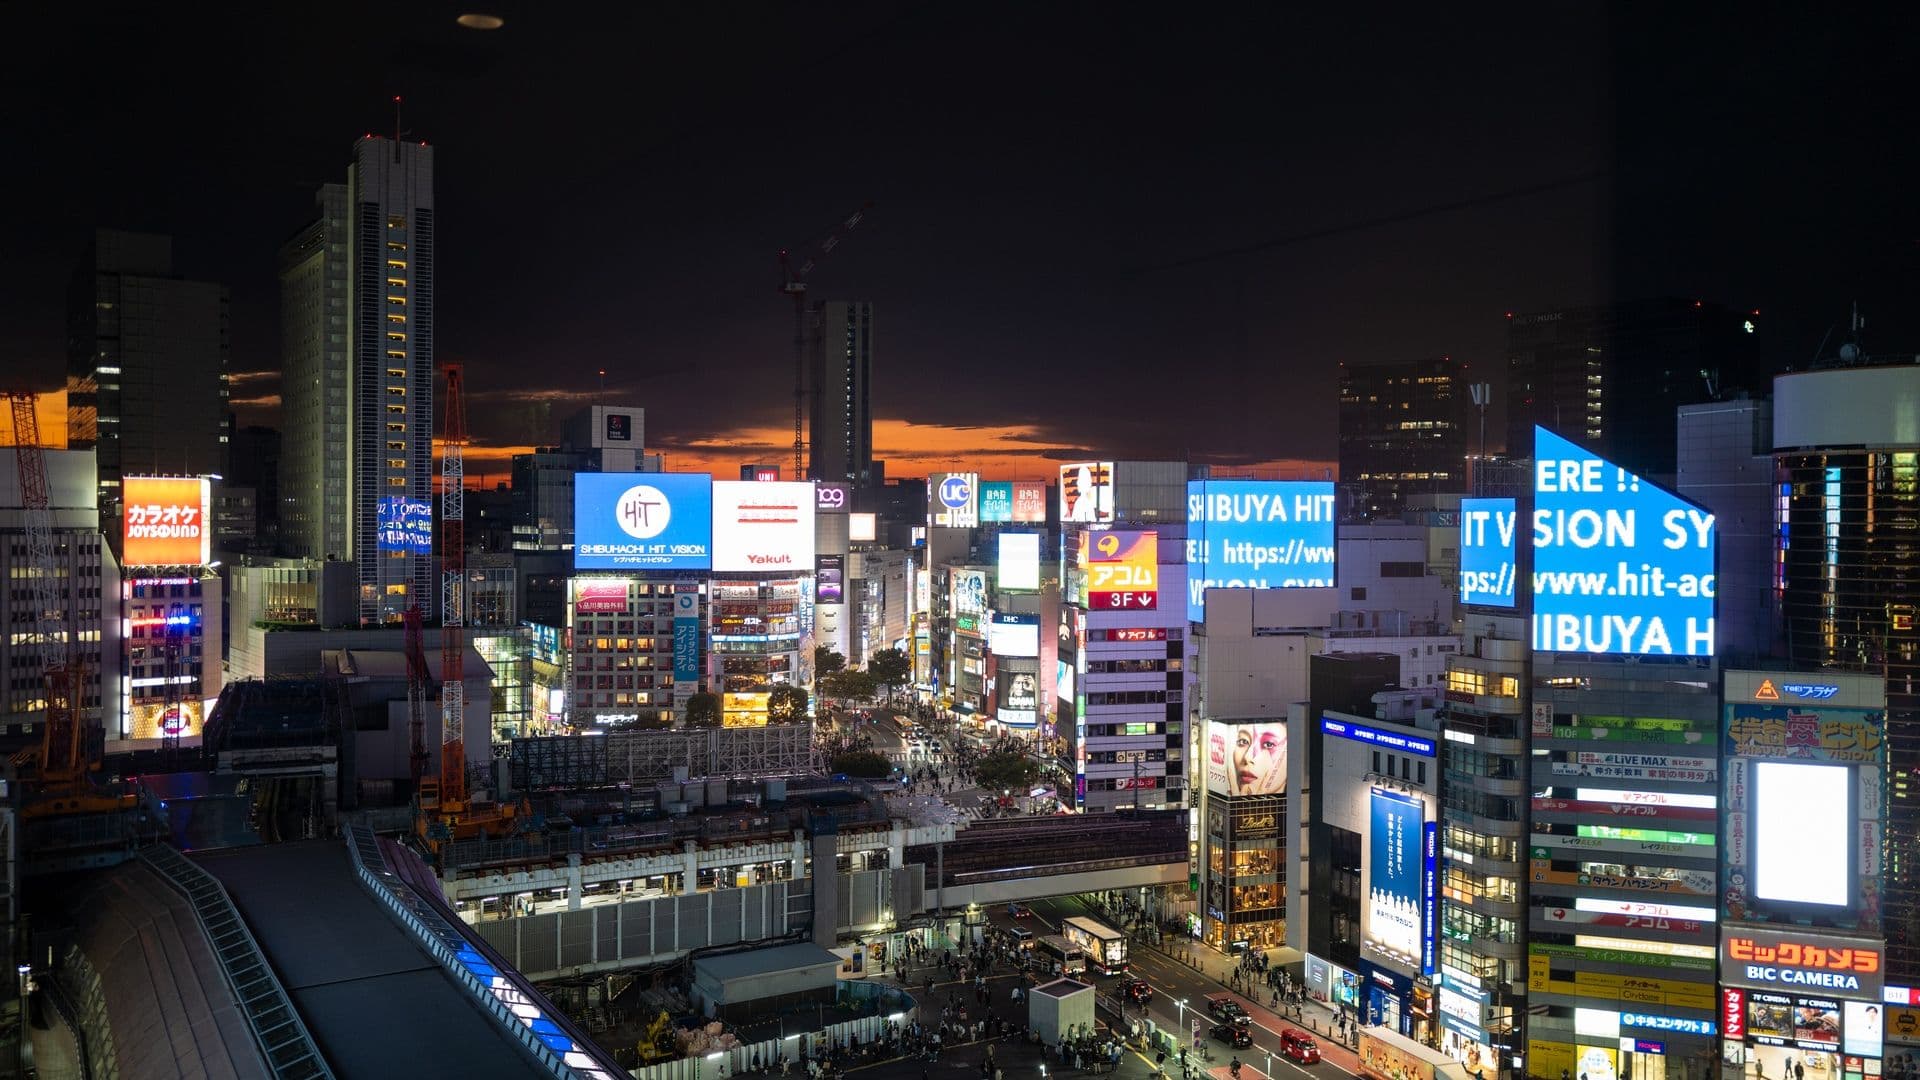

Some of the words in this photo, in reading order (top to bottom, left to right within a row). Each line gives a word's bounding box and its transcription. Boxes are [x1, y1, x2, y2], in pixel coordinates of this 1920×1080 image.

[1537, 460, 1603, 492] ERE
[817, 488, 844, 508] 109
[128, 504, 198, 525] カラオケ
[1188, 494, 1287, 522] SHIBUYA
[1295, 494, 1335, 522] HIT
[128, 524, 199, 538] JOYSOUND
[1533, 509, 1635, 548] SION
[1663, 509, 1715, 549] SY
[580, 544, 644, 554] SHIBUHACHI
[649, 544, 666, 554] HIT
[670, 544, 705, 554] VISION
[748, 554, 792, 564] Yakult
[1094, 566, 1152, 586] アコム
[1112, 592, 1133, 606] 3F
[1128, 631, 1155, 639] アイフル
[1686, 617, 1714, 656] H
[676, 626, 686, 671] アイシティ
[688, 626, 696, 671] コンタクトの
[1642, 758, 1667, 766] MAX
[1634, 793, 1667, 804] アイフル
[1622, 805, 1657, 815] アイフル
[1592, 876, 1670, 890] タウンハウジング
[1634, 904, 1668, 916] アコム
[1626, 916, 1670, 930] アコム
[1730, 938, 1879, 973] ビックカメラ
[1746, 966, 1777, 981] BIC
[1780, 969, 1859, 990] CAMERA
[1762, 995, 1791, 1004] CINEMA
[1808, 1000, 1838, 1010] CINEMA
[1727, 991, 1741, 1033] カラオケ
[1636, 1016, 1700, 1032] 中央コンタクト
